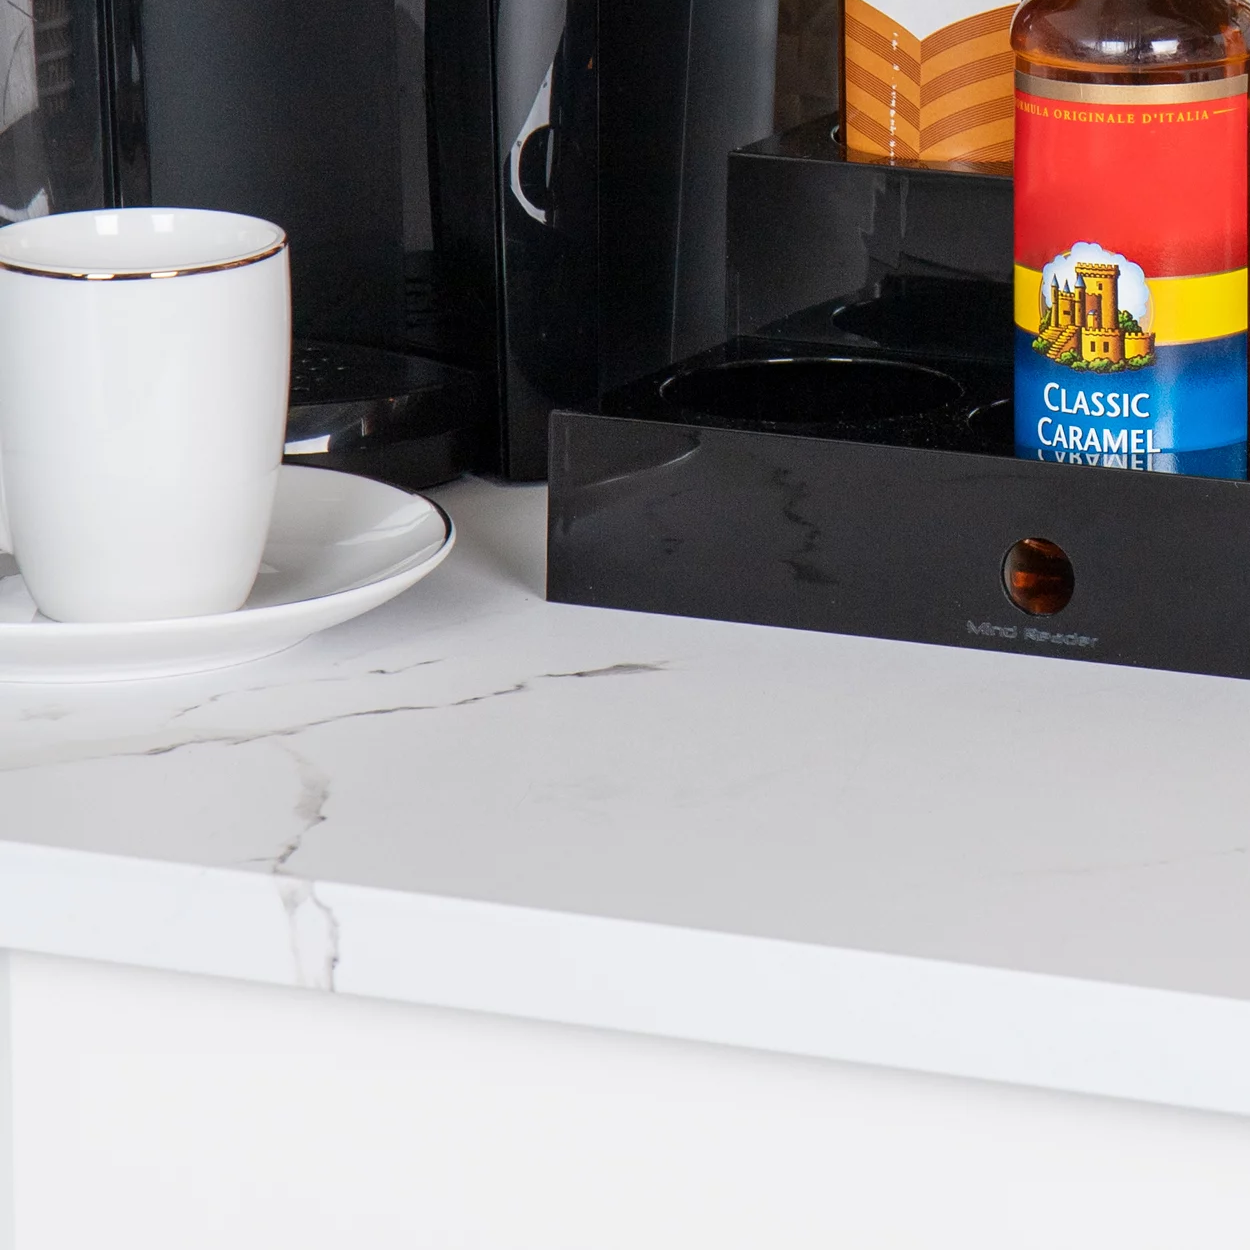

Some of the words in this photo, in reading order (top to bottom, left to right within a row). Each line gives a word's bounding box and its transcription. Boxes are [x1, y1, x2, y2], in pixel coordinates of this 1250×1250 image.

[1016, 99, 1049, 117] RMULA
[1053, 108, 1135, 124] ORIGINALE
[1142, 110, 1210, 124] D'ITALIA
[1043, 382, 1151, 418] CLASSIC
[1037, 417, 1162, 455] CARAMEL
